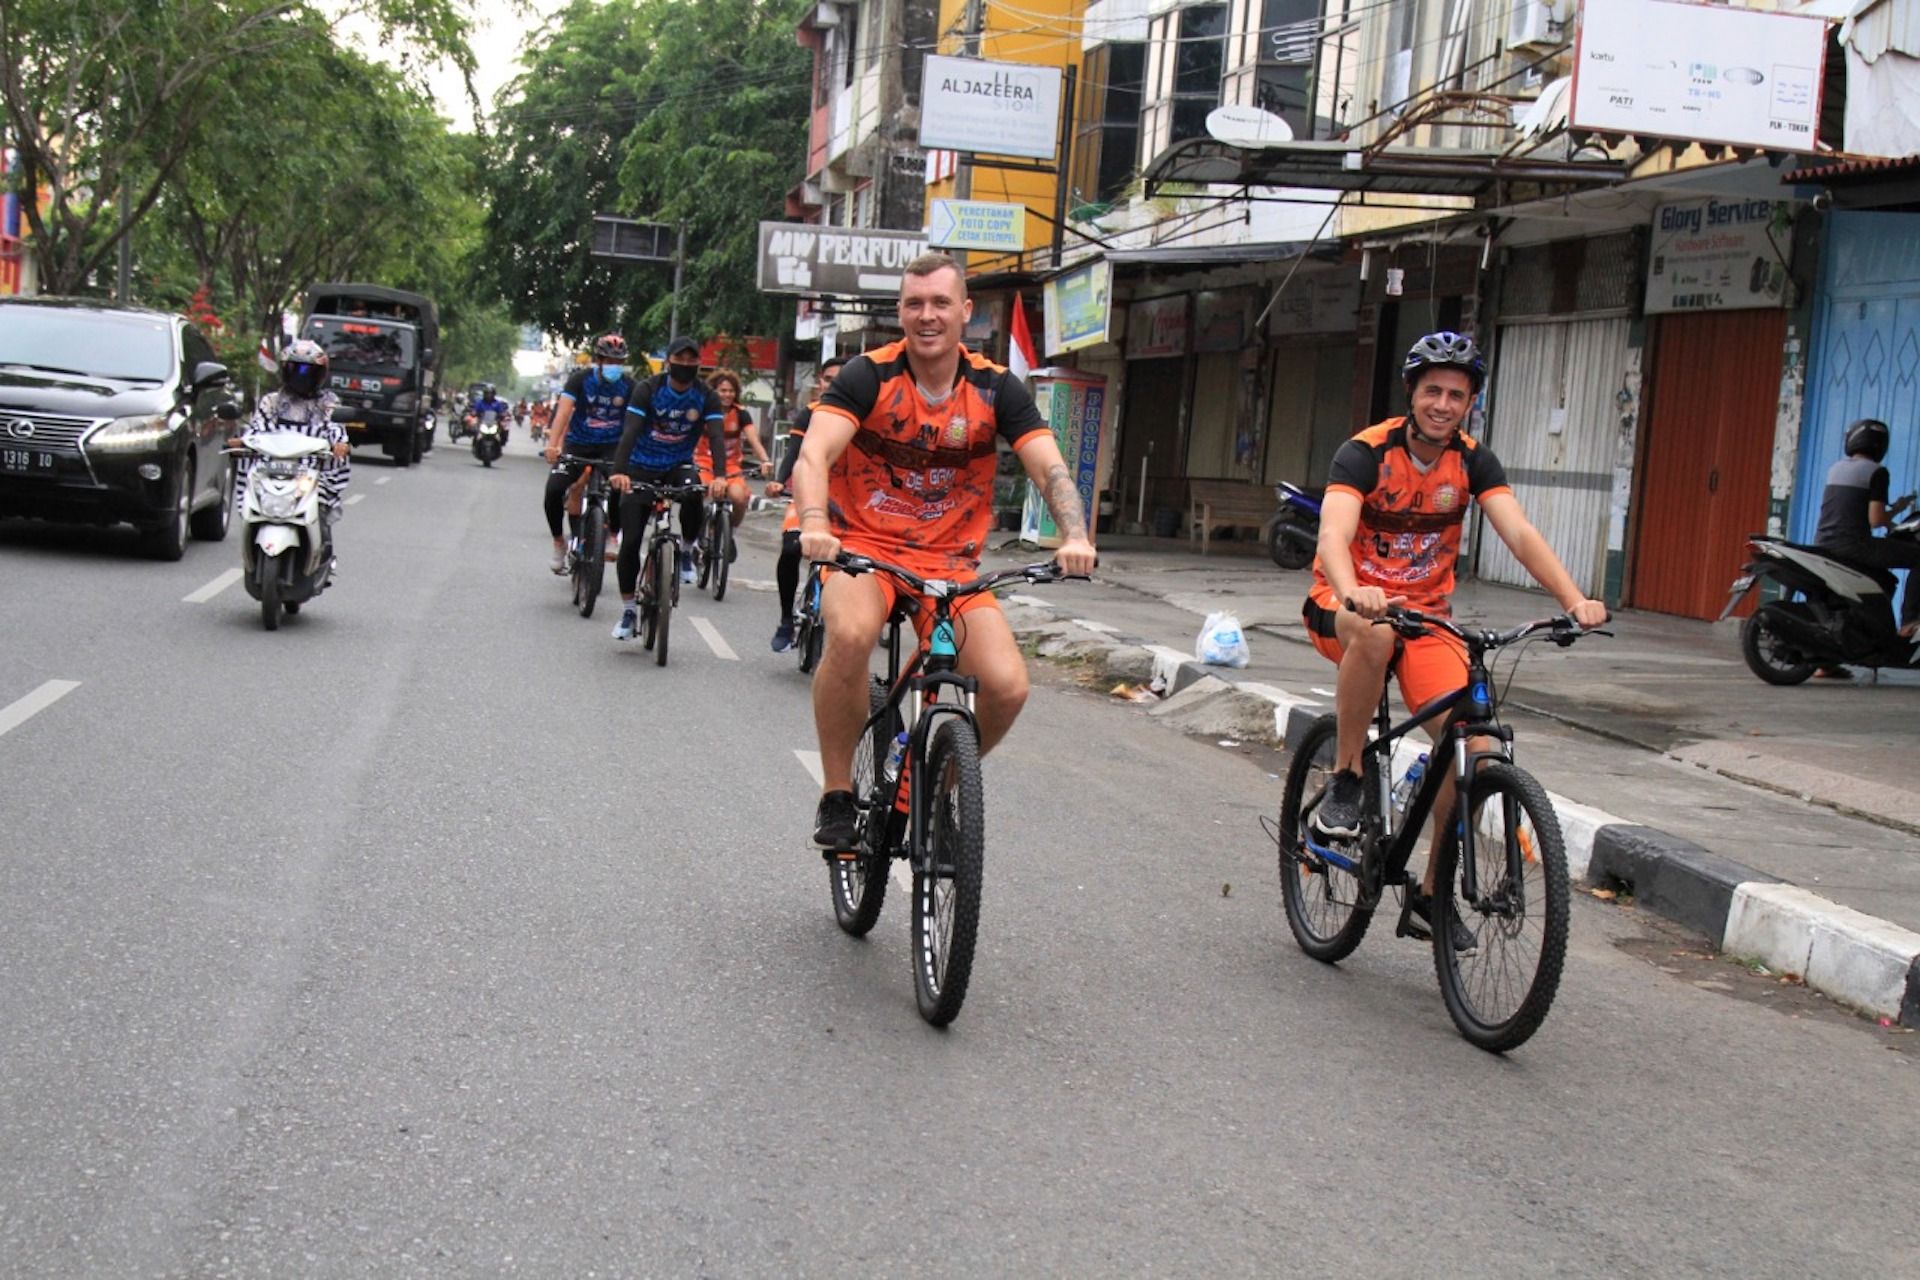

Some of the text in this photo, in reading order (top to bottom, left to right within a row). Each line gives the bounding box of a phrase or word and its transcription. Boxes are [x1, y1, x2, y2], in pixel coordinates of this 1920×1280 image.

[941, 75, 1032, 100] ALJAZEERA
[1661, 199, 1769, 234] Glory Service
[768, 229, 817, 257] MW
